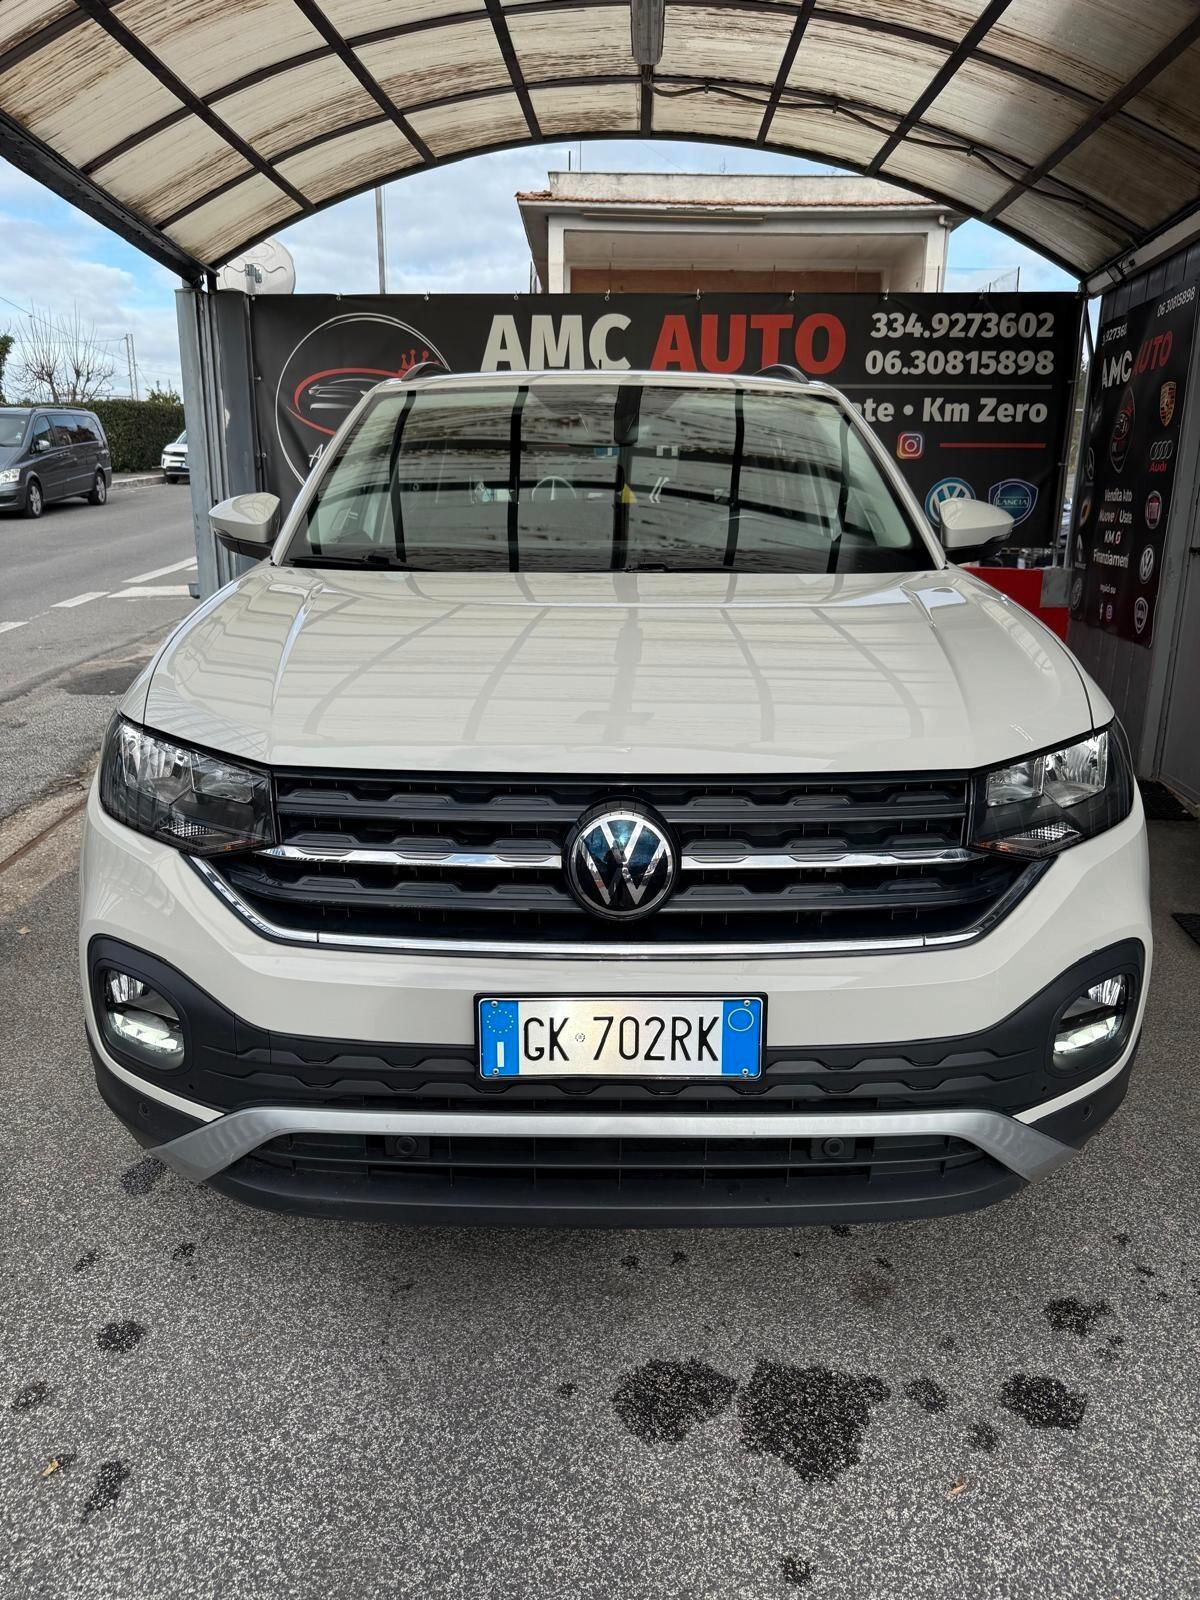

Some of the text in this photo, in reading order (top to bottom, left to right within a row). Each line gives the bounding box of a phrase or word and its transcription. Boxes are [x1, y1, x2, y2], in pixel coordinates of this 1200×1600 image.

[869, 312, 1055, 339] 334.9273602
[480, 312, 847, 374] AMC AUTO
[864, 349, 1055, 376] 06.30815898
[1101, 330, 1174, 390] AMC AUTO
[922, 397, 970, 423] Km
[977, 397, 1049, 424] Zero
[1149, 461, 1168, 473] Audi
[996, 498, 1028, 507] LANCIA
[522, 1016, 570, 1062] GK
[592, 1015, 720, 1062] 702RK
